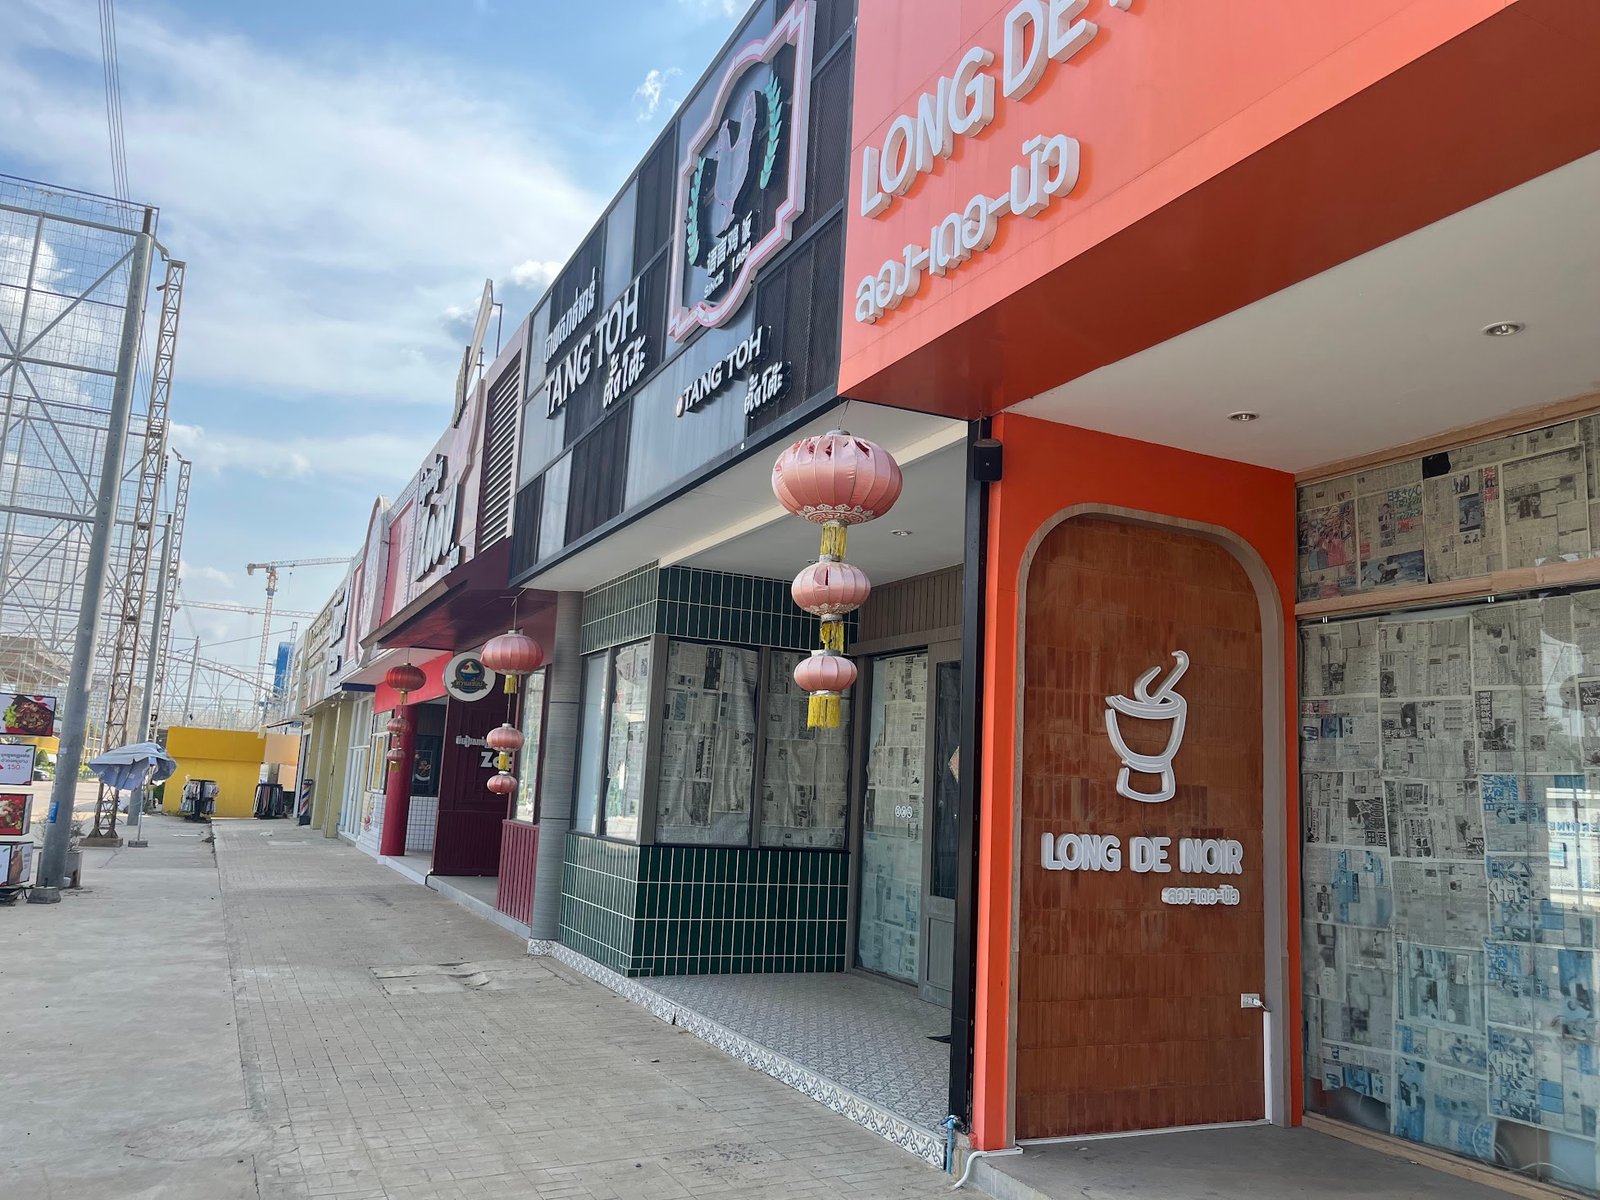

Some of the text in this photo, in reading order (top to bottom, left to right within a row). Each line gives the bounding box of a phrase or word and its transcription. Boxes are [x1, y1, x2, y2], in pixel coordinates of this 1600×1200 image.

[861, 0, 1098, 218] LONG DE
[545, 276, 642, 418] TANG TOH
[684, 325, 762, 412] TANG TOH
[1041, 832, 1244, 874] LONG DE NOIR
